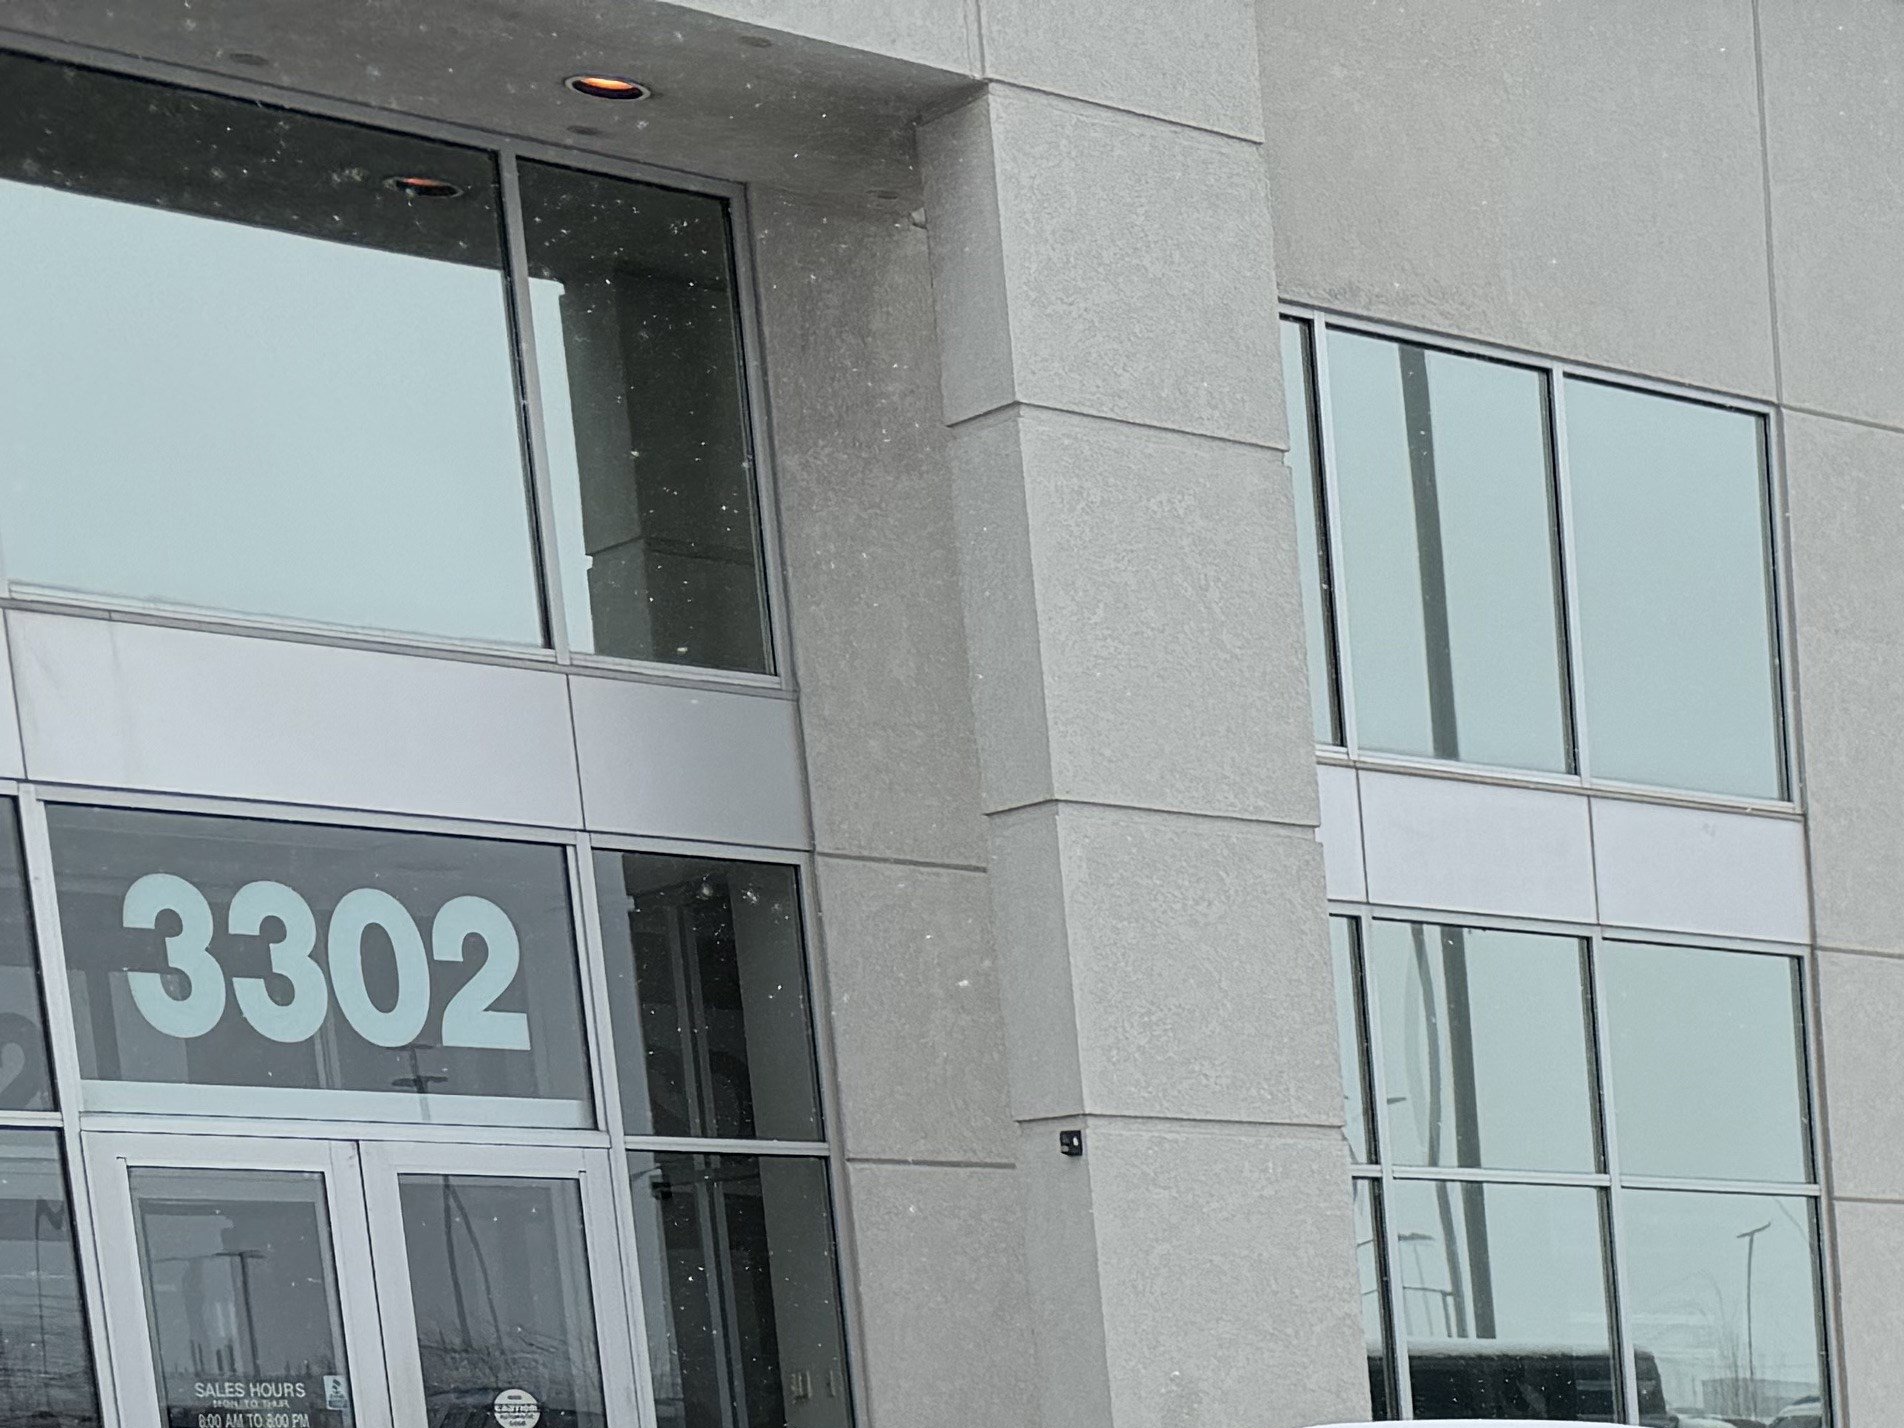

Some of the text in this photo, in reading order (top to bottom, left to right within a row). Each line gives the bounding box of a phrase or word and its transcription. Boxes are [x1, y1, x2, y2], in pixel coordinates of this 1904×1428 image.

[122, 873, 531, 1050] 3302
[194, 1382, 306, 1398] SALES HOURS
[225, 1413, 244, 1428] AM
[247, 1413, 262, 1428] TO
[292, 1413, 310, 1428] PM
